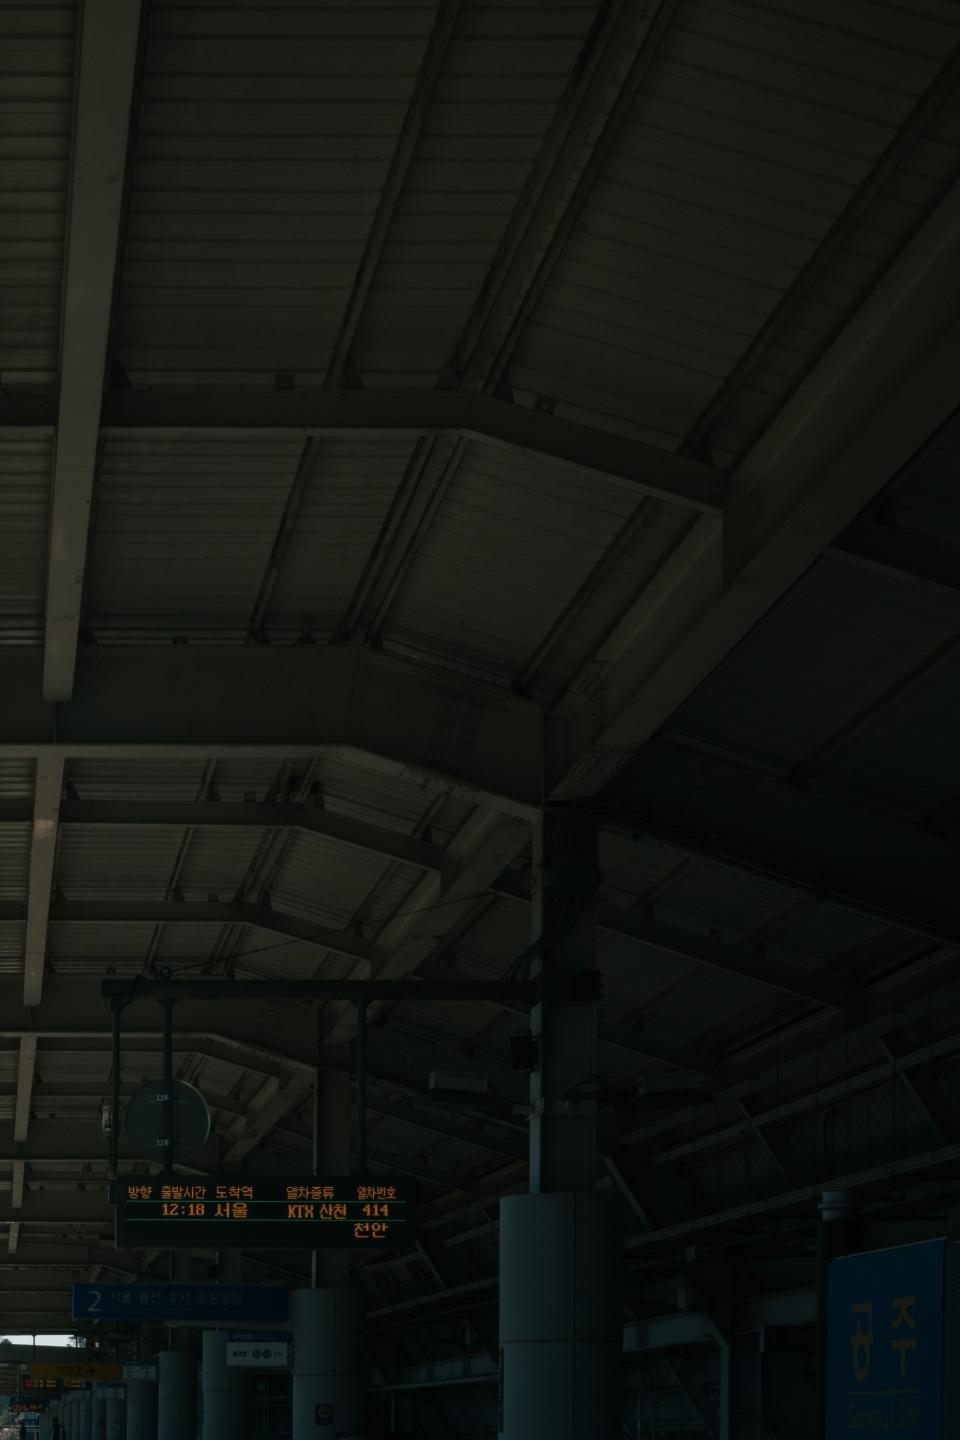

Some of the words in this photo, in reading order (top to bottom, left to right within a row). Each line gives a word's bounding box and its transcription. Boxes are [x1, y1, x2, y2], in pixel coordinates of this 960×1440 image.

[128, 1185, 153, 1200] 방향
[160, 1184, 207, 1200] 출발시간
[215, 1184, 254, 1200] 도착역
[286, 1185, 335, 1200] 열차종류
[356, 1185, 398, 1200] 열차번호
[161, 1203, 205, 1217] 12:18
[214, 1203, 249, 1219] 서울
[288, 1204, 314, 1218] KTX
[319, 1203, 348, 1220] 산천
[362, 1203, 390, 1217] 414
[353, 1222, 388, 1239] 천안
[87, 1290, 102, 1312] 2
[848, 1295, 919, 1382] 공주
